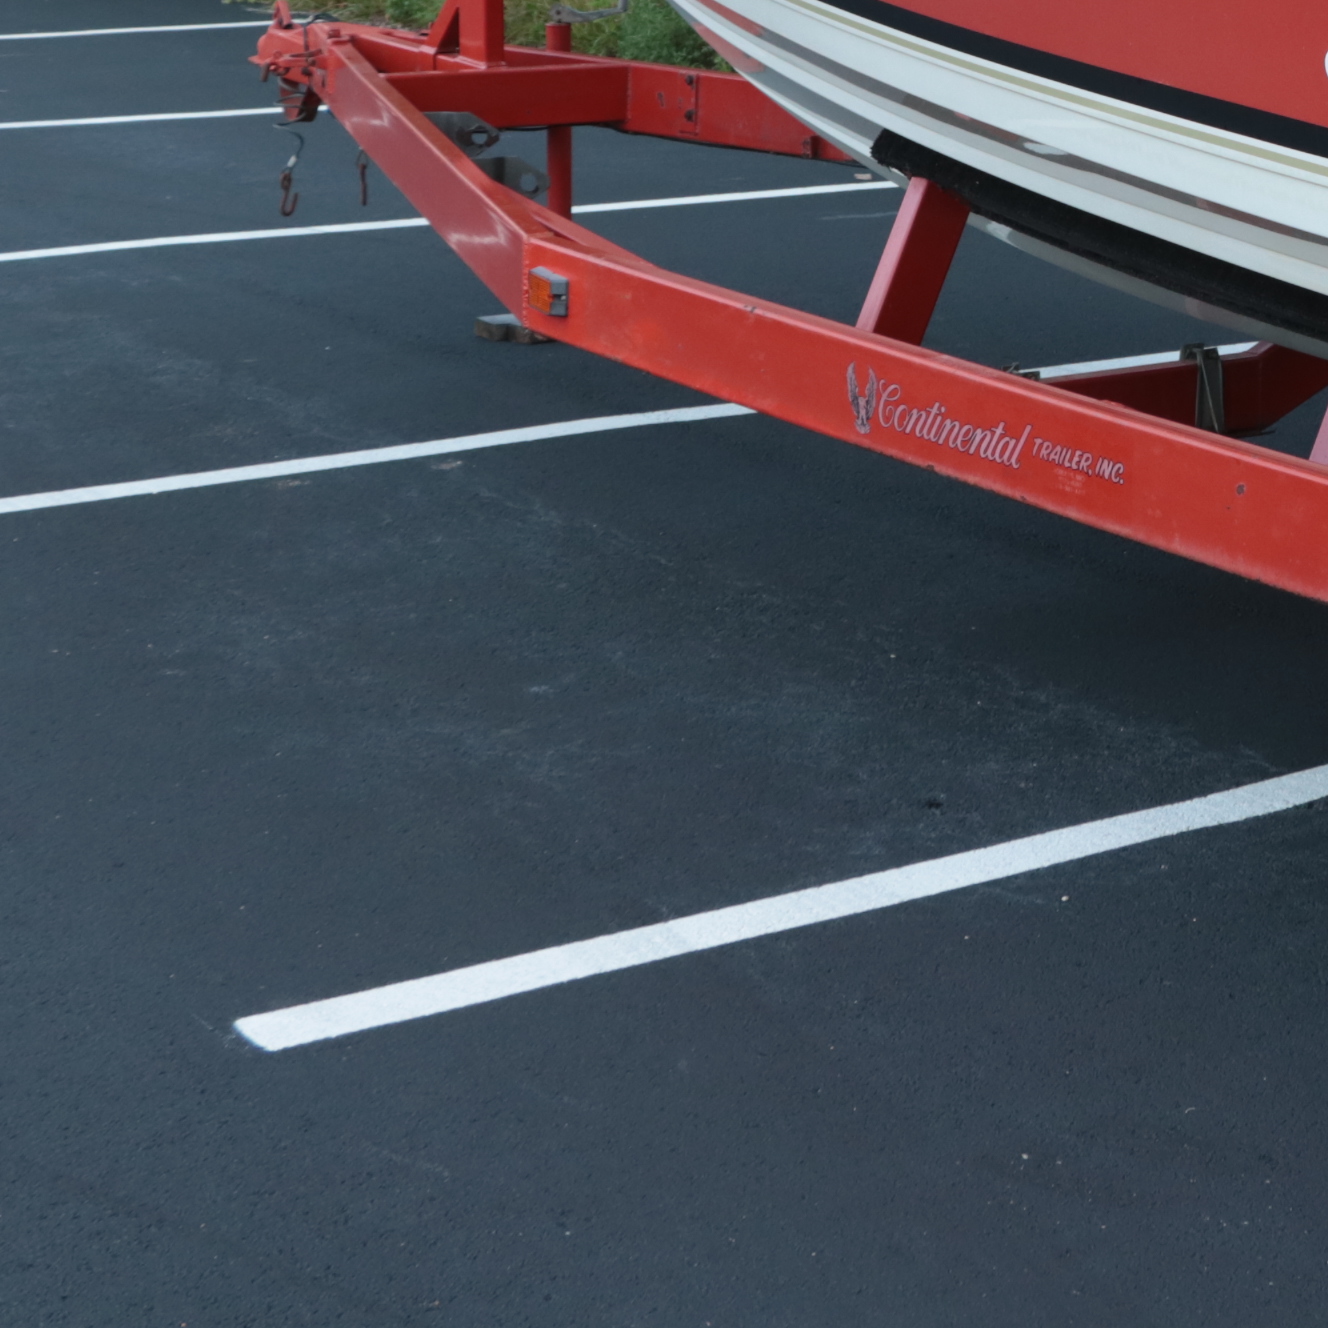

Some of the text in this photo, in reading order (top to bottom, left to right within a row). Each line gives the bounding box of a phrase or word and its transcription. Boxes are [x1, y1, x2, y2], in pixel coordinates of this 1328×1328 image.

[877, 377, 1033, 470] Continental
[1032, 437, 1093, 478] TRAILER,
[1095, 455, 1125, 485] INC.
